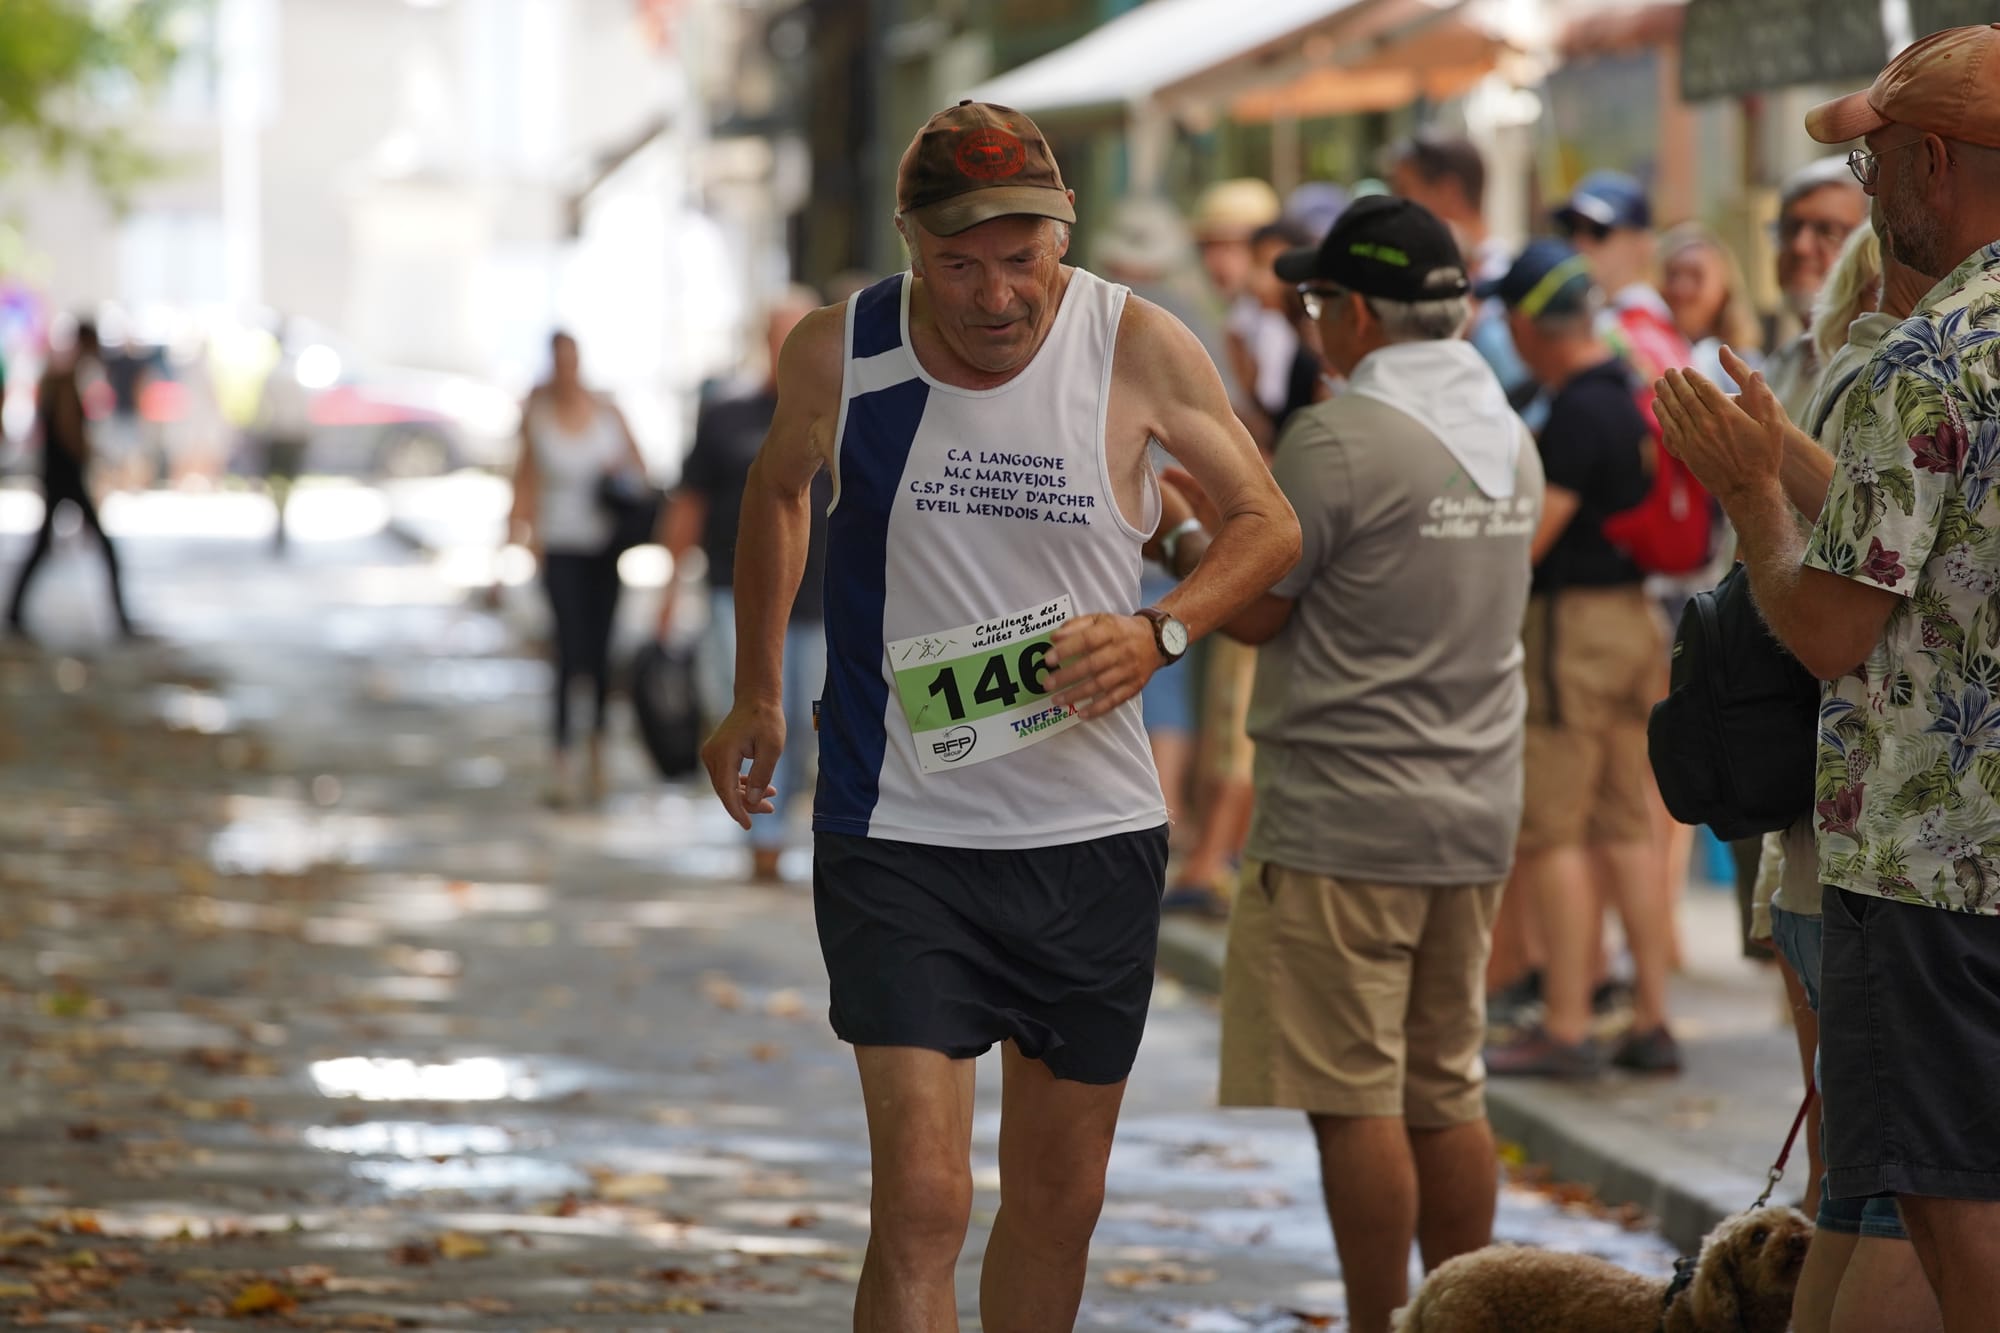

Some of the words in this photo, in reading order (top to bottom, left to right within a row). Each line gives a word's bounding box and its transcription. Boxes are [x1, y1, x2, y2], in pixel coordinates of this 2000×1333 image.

[947, 449, 972, 463] C.A
[980, 451, 1064, 470] LANGOGNE
[944, 466, 972, 480] M.C
[975, 468, 1066, 488] MARVEJOLS
[910, 481, 944, 495] C.S.P
[950, 484, 966, 496] St
[970, 486, 1019, 501] CHELY
[1026, 490, 1095, 508] D'APCHER
[916, 498, 961, 514] EVEIL
[966, 502, 1038, 520] MENDOIS
[1043, 511, 1091, 525] A.C.M.
[972, 630, 1012, 648] vallées
[1019, 612, 1066, 635] cévenoles
[976, 614, 1034, 636] Challenge
[1040, 603, 1058, 617] des
[928, 641, 1062, 721] 146
[1010, 705, 1062, 732] TUFF'S
[1019, 711, 1068, 738] Aventure
[932, 736, 971, 755] BFP
